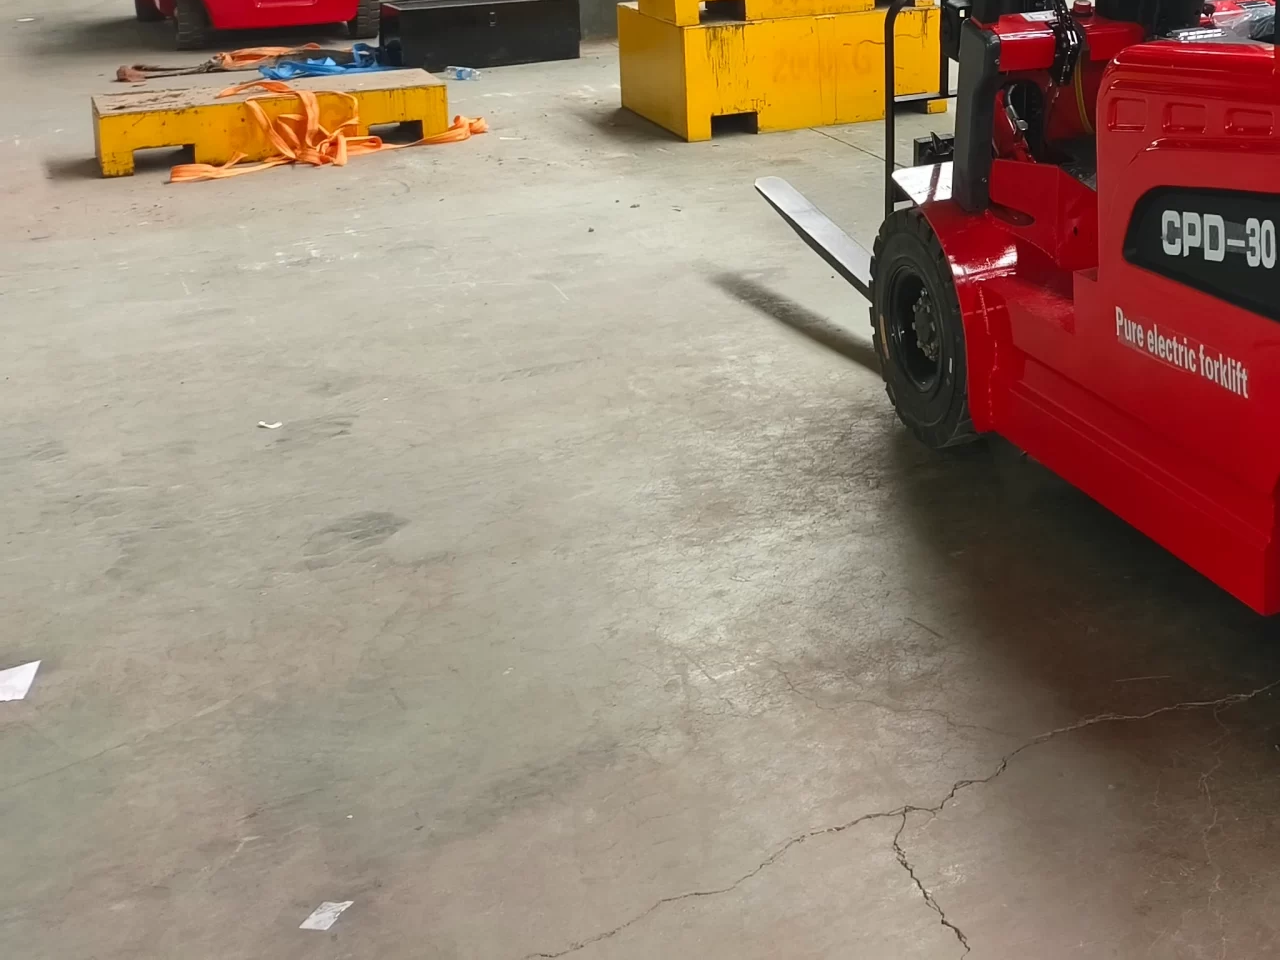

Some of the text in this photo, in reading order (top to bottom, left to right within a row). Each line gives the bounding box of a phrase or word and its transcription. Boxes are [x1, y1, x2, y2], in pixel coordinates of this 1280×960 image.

[1161, 209, 1277, 270] CPD-30
[1115, 306, 1250, 400] Pure electric forklift
